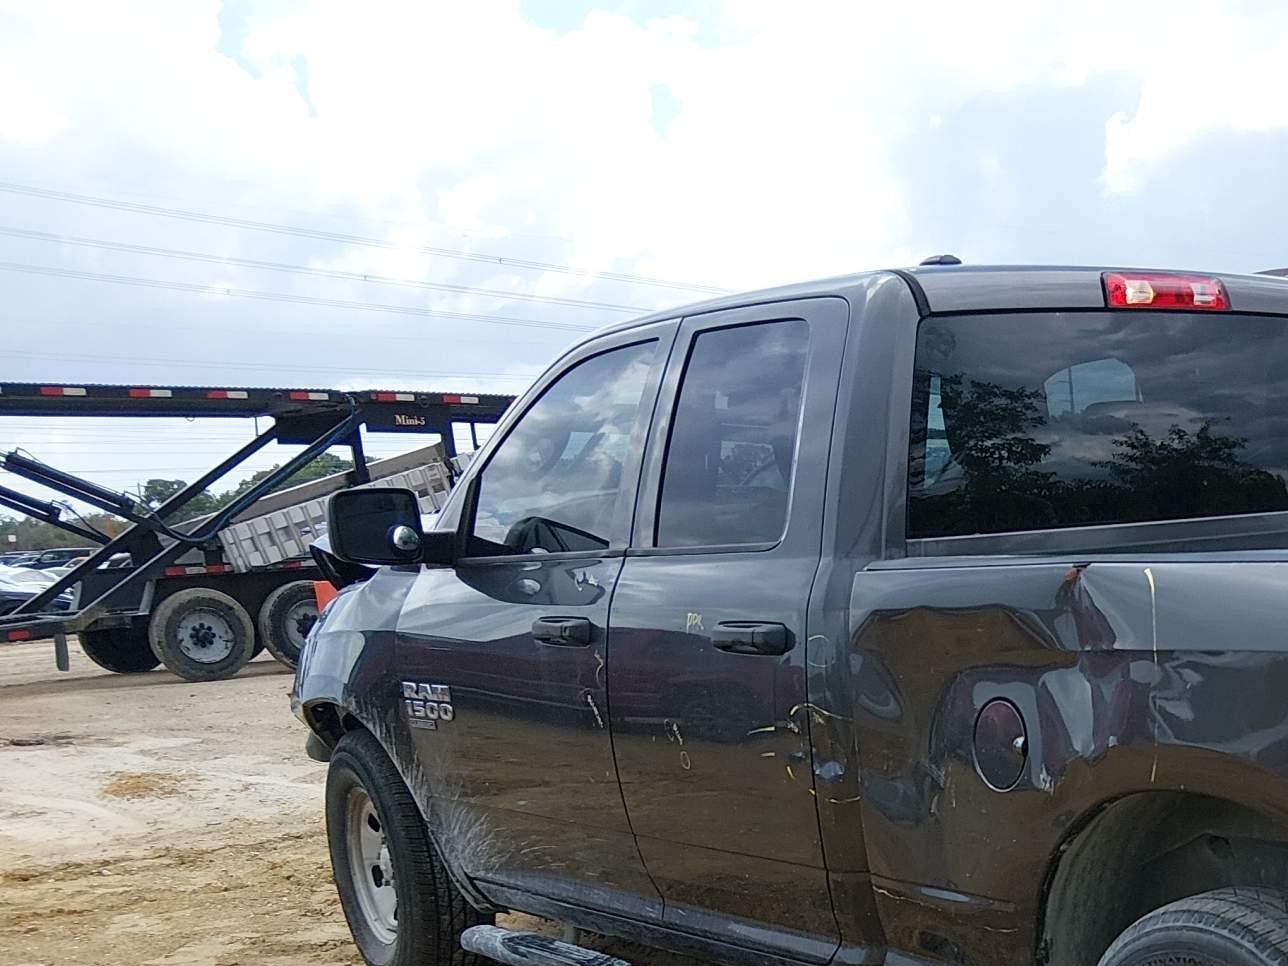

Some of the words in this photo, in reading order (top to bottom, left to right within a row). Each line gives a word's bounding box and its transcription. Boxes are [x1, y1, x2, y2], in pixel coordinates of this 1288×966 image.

[393, 414, 426, 426] Mini-5
[401, 681, 451, 702] RAM
[405, 699, 454, 721] 1500
